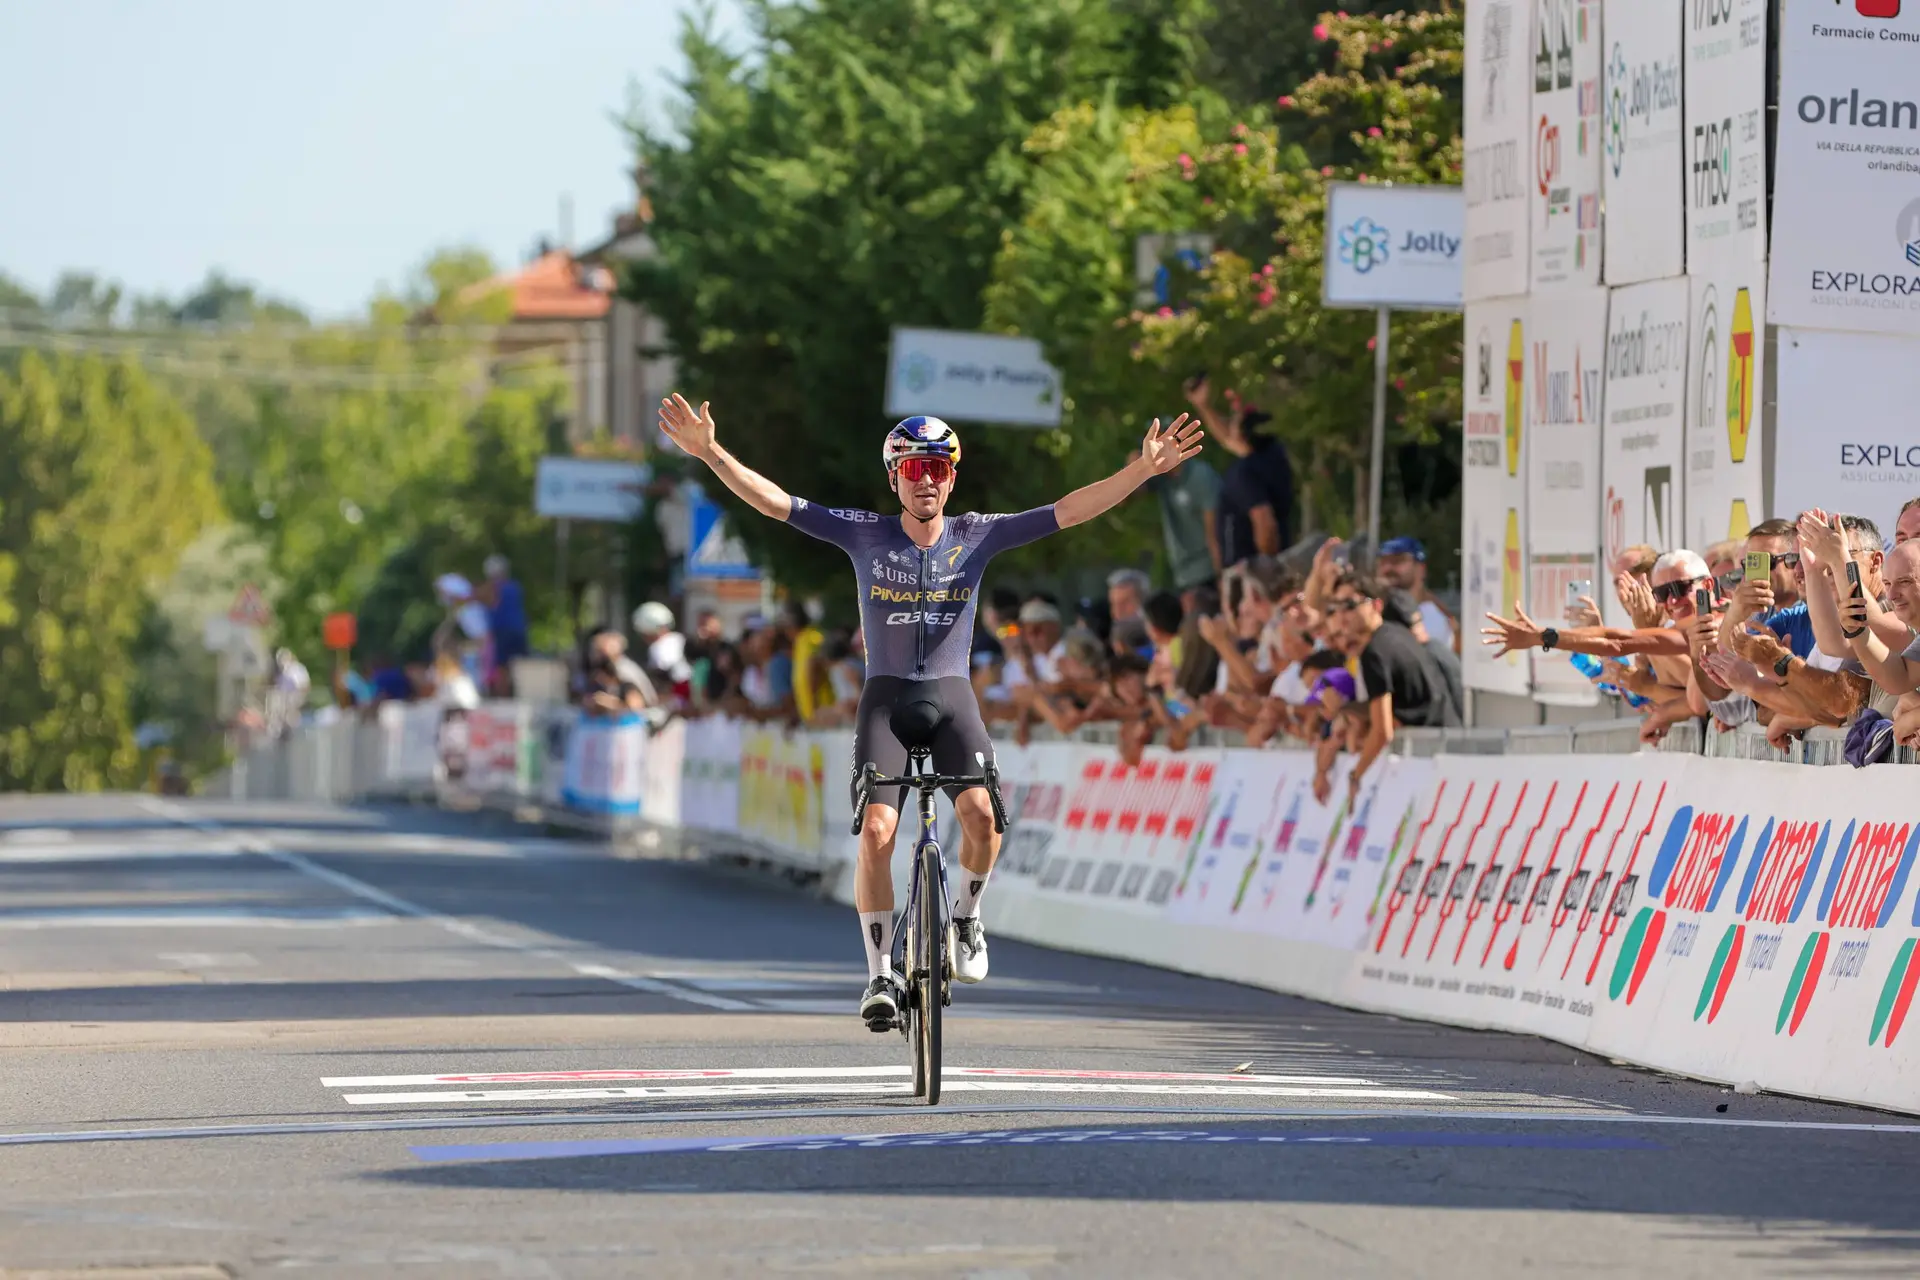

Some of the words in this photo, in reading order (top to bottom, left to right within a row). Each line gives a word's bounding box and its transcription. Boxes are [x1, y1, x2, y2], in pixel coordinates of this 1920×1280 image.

[1812, 24, 1875, 40] Farmacie
[1879, 28, 1920, 43] Comu
[1797, 88, 1918, 130] orlan
[1816, 141, 1832, 151] VIA
[1834, 142, 1862, 153] DELLA
[1864, 144, 1920, 156] REPUBBLICA
[1693, 117, 1732, 208] FABO
[1867, 160, 1920, 174] orlandiba
[1399, 231, 1461, 258] Jolly
[1841, 444, 1920, 468] EXPLO
[1840, 471, 1920, 484] ASSICURAZI
[828, 508, 880, 523] Q36.5
[886, 566, 917, 585] UBS
[870, 585, 971, 603] PINARELLO
[886, 611, 957, 626] Q36.5
[1664, 811, 1735, 914] oma
[1745, 820, 1819, 925] oma
[1828, 821, 1909, 931] oma
